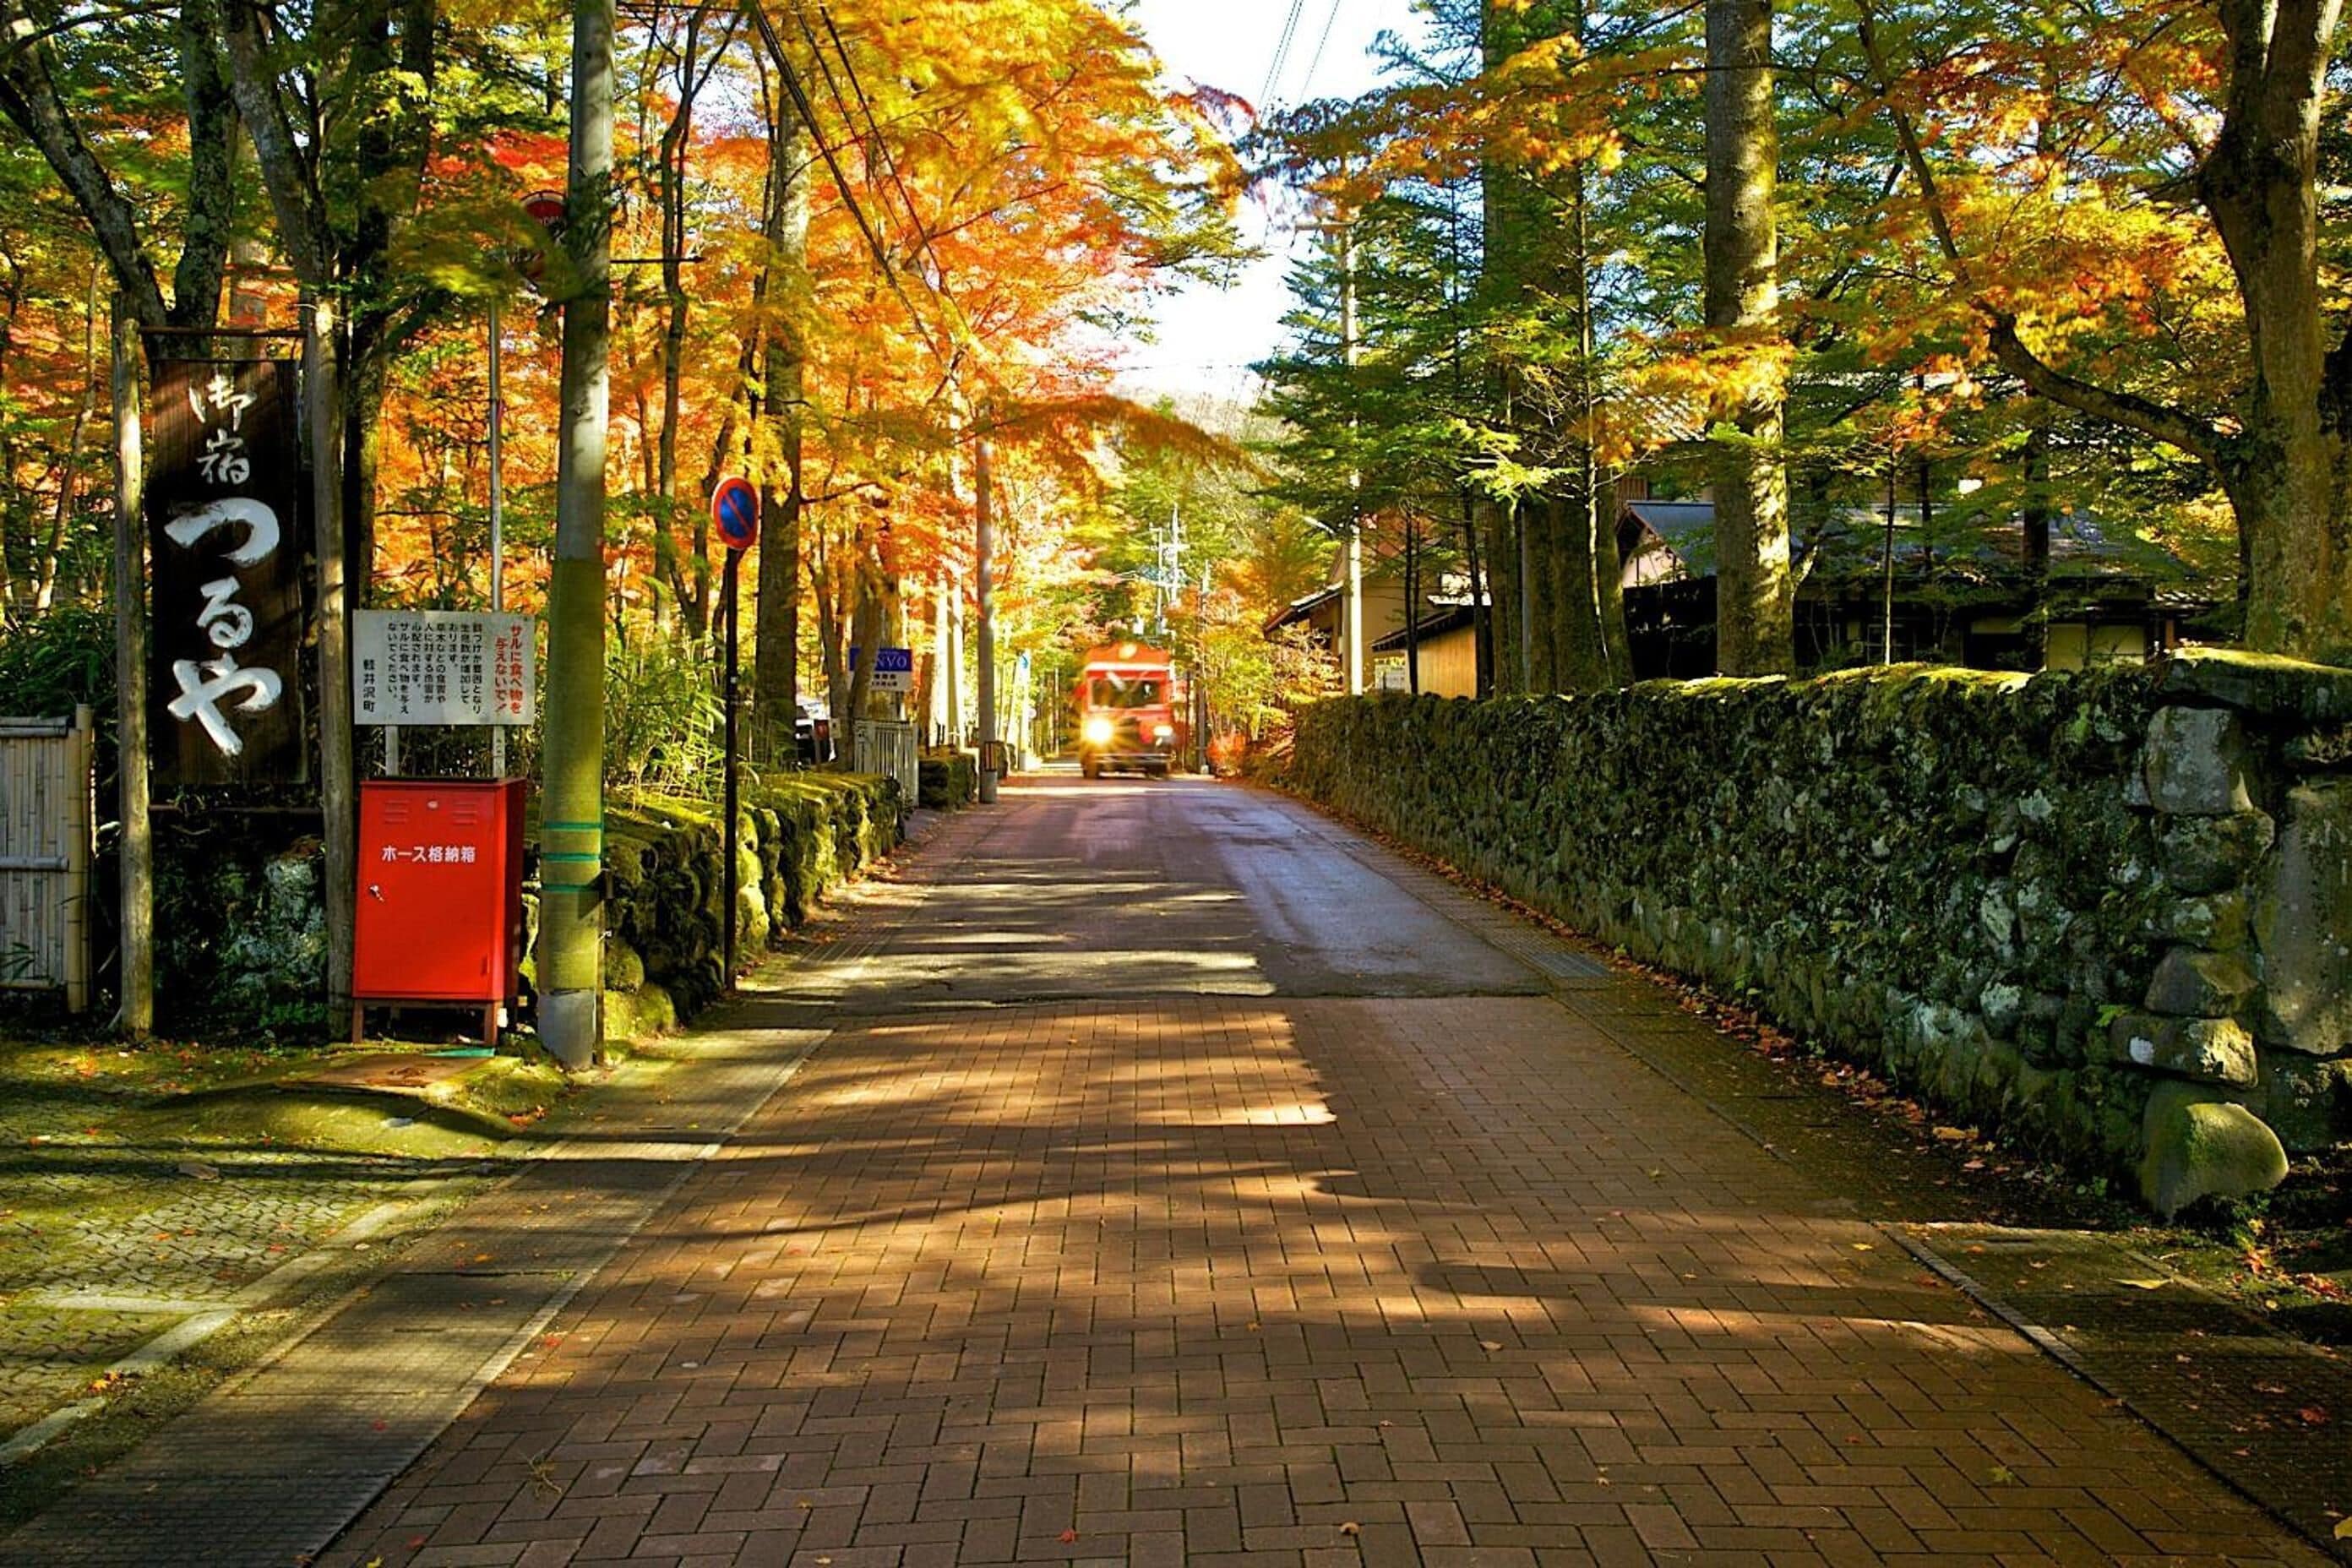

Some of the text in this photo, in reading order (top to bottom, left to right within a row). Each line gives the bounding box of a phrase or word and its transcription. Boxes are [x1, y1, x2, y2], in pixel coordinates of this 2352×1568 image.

[163, 373, 284, 757] 御宿 つるや
[362, 658, 376, 713] 軽井沢町
[388, 622, 399, 699] ないでください。
[399, 622, 411, 714] サルに食べ物を与え
[509, 624, 524, 714] サルに食べ物を
[382, 845, 476, 863] ホース格納箱
